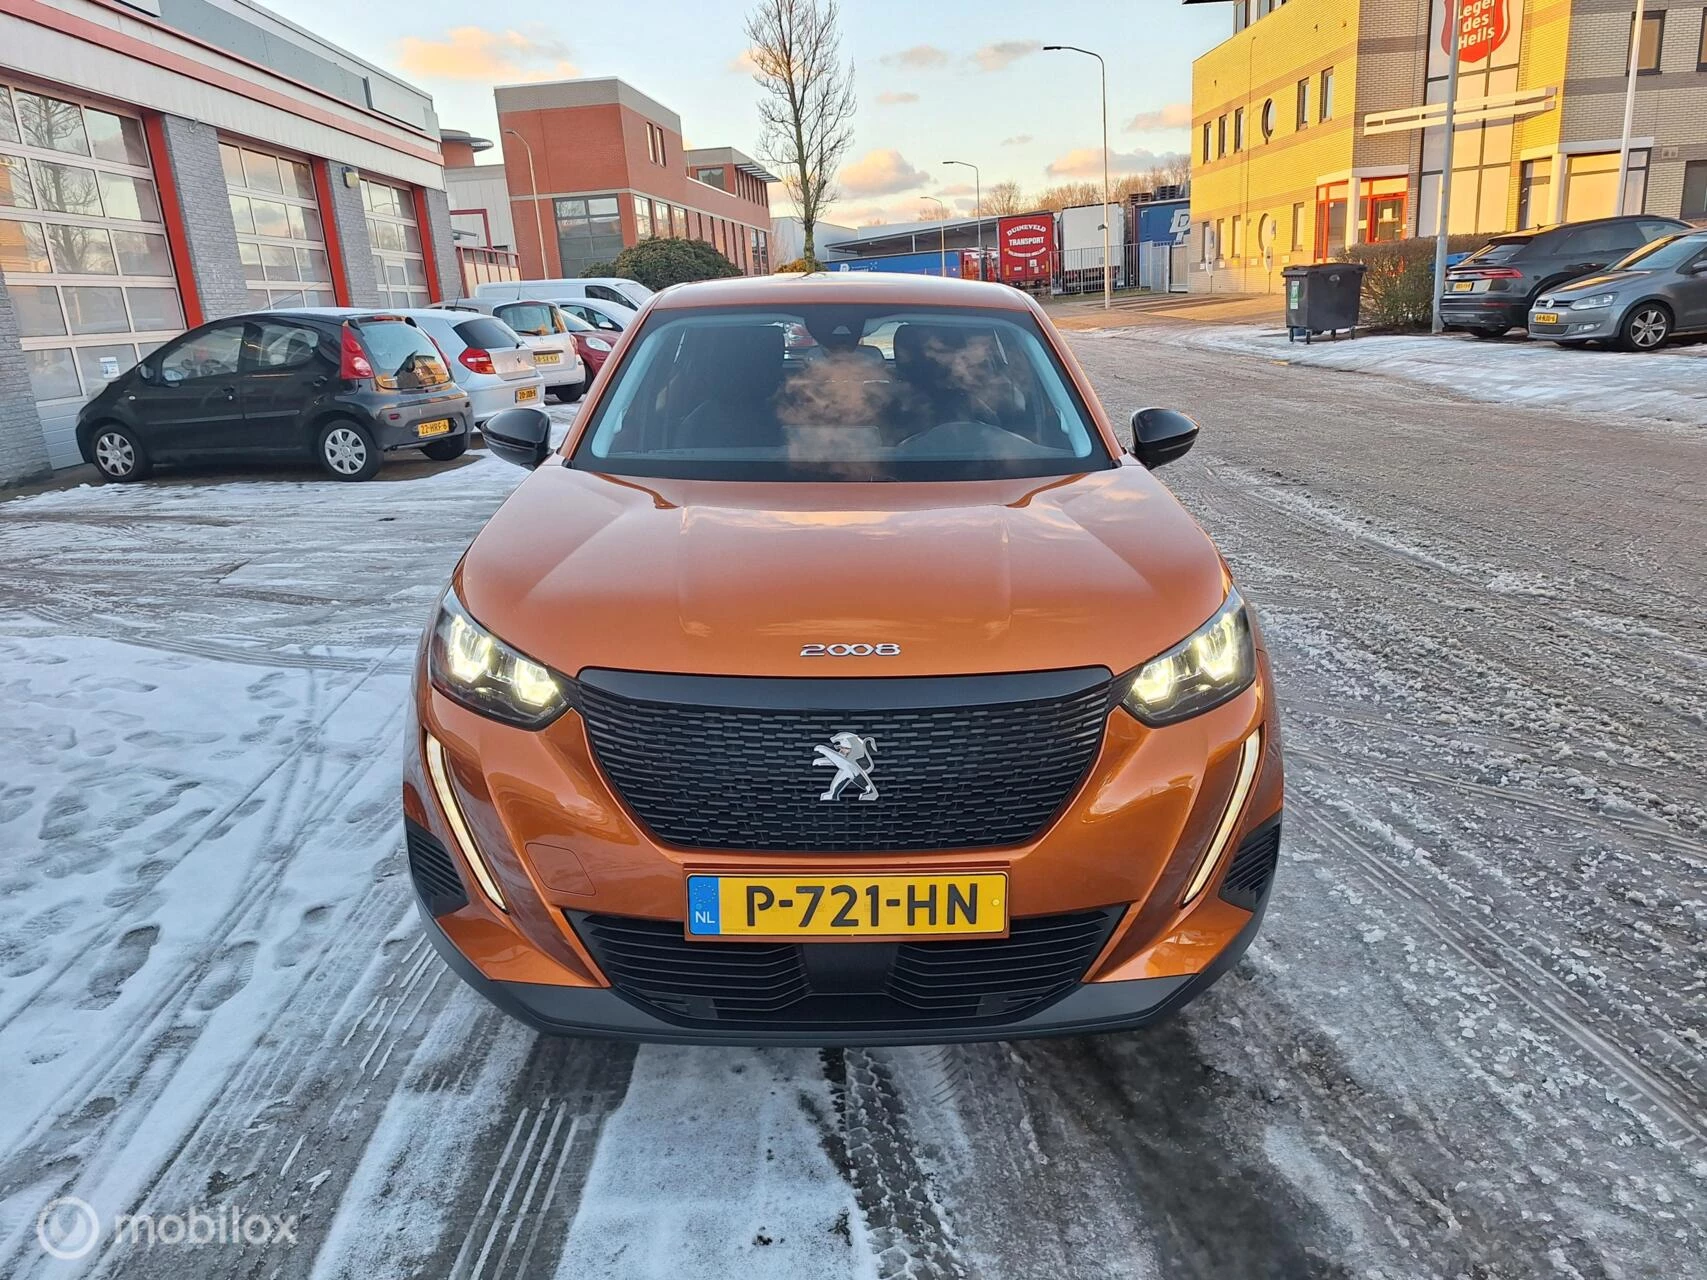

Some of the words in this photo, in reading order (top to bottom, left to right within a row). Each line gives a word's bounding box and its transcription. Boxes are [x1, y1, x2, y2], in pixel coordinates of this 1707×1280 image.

[1462, 13, 1489, 33] des
[1458, 26, 1495, 50] Heils
[1008, 236, 1044, 246] TRANSPORT
[799, 643, 901, 657] 2008
[745, 883, 978, 927] P-721-HN
[695, 911, 715, 924] NL
